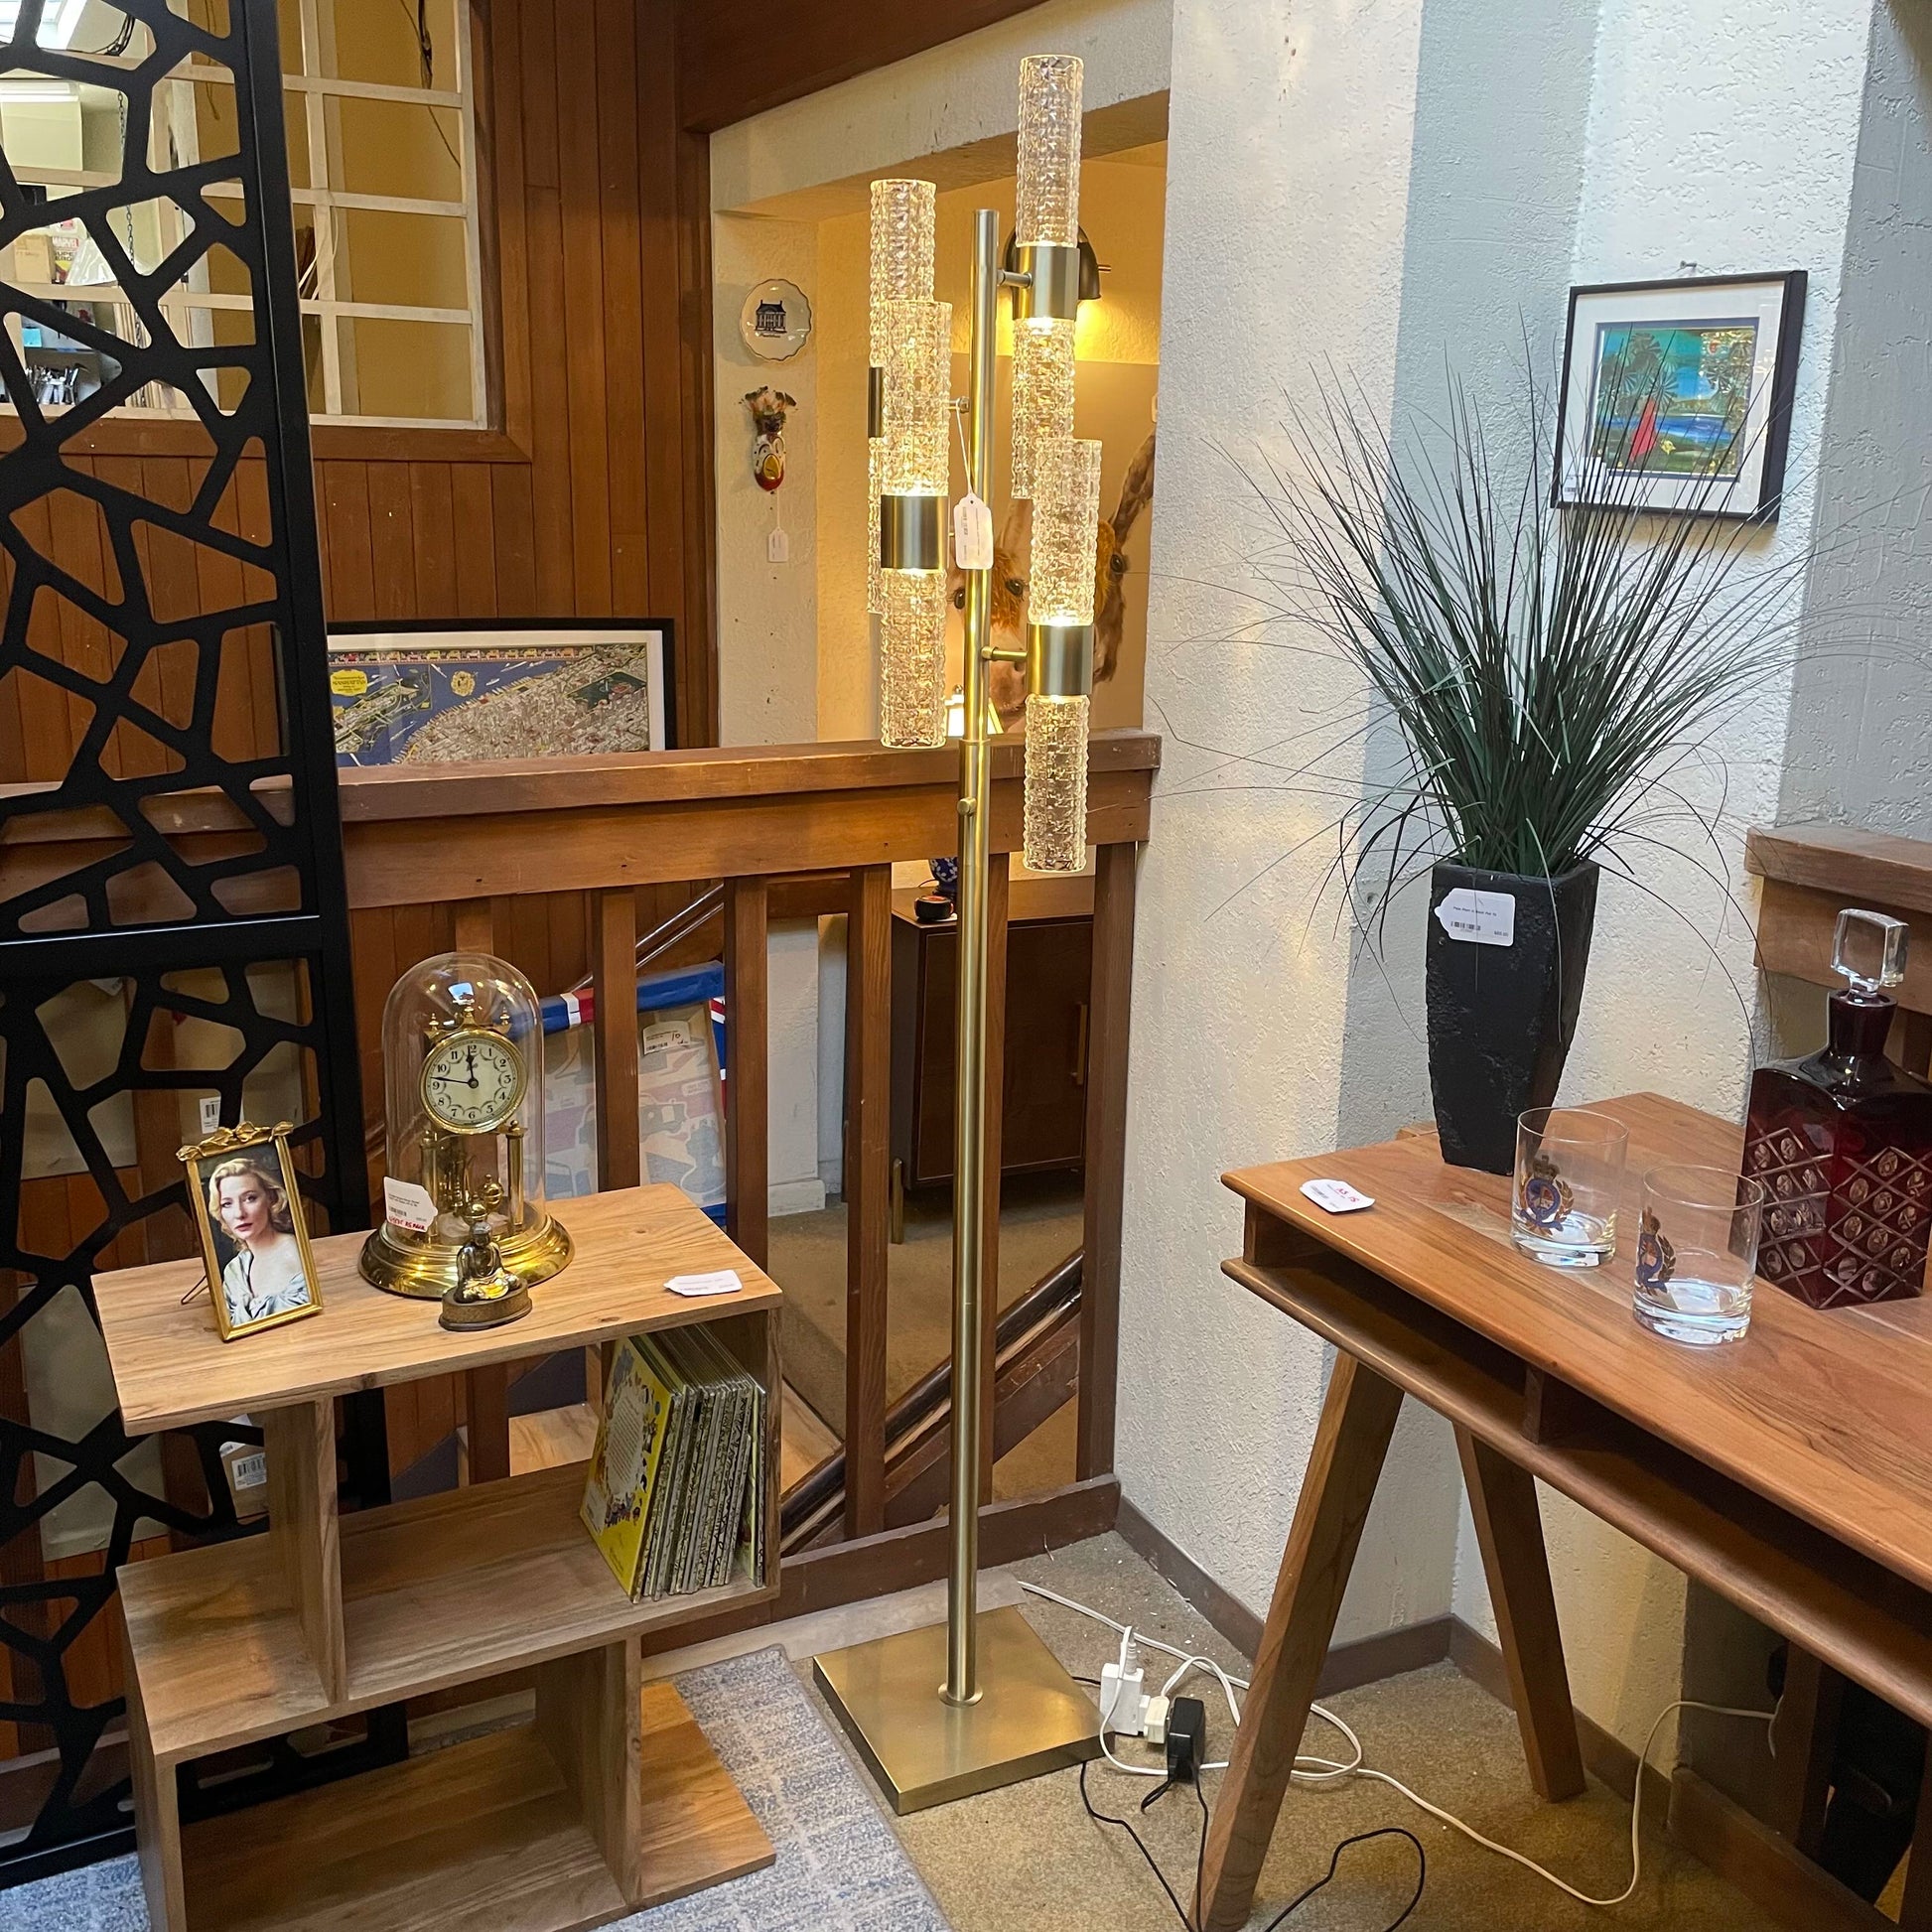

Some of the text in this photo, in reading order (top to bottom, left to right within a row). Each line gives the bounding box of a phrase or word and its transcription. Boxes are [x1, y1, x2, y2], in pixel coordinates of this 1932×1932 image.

[451, 1050, 458, 1059] 11
[499, 1058, 506, 1067] 2
[437, 1063, 447, 1072] 10
[503, 1074, 511, 1084] 3
[432, 1081, 440, 1090] 9
[498, 1092, 505, 1101] 4
